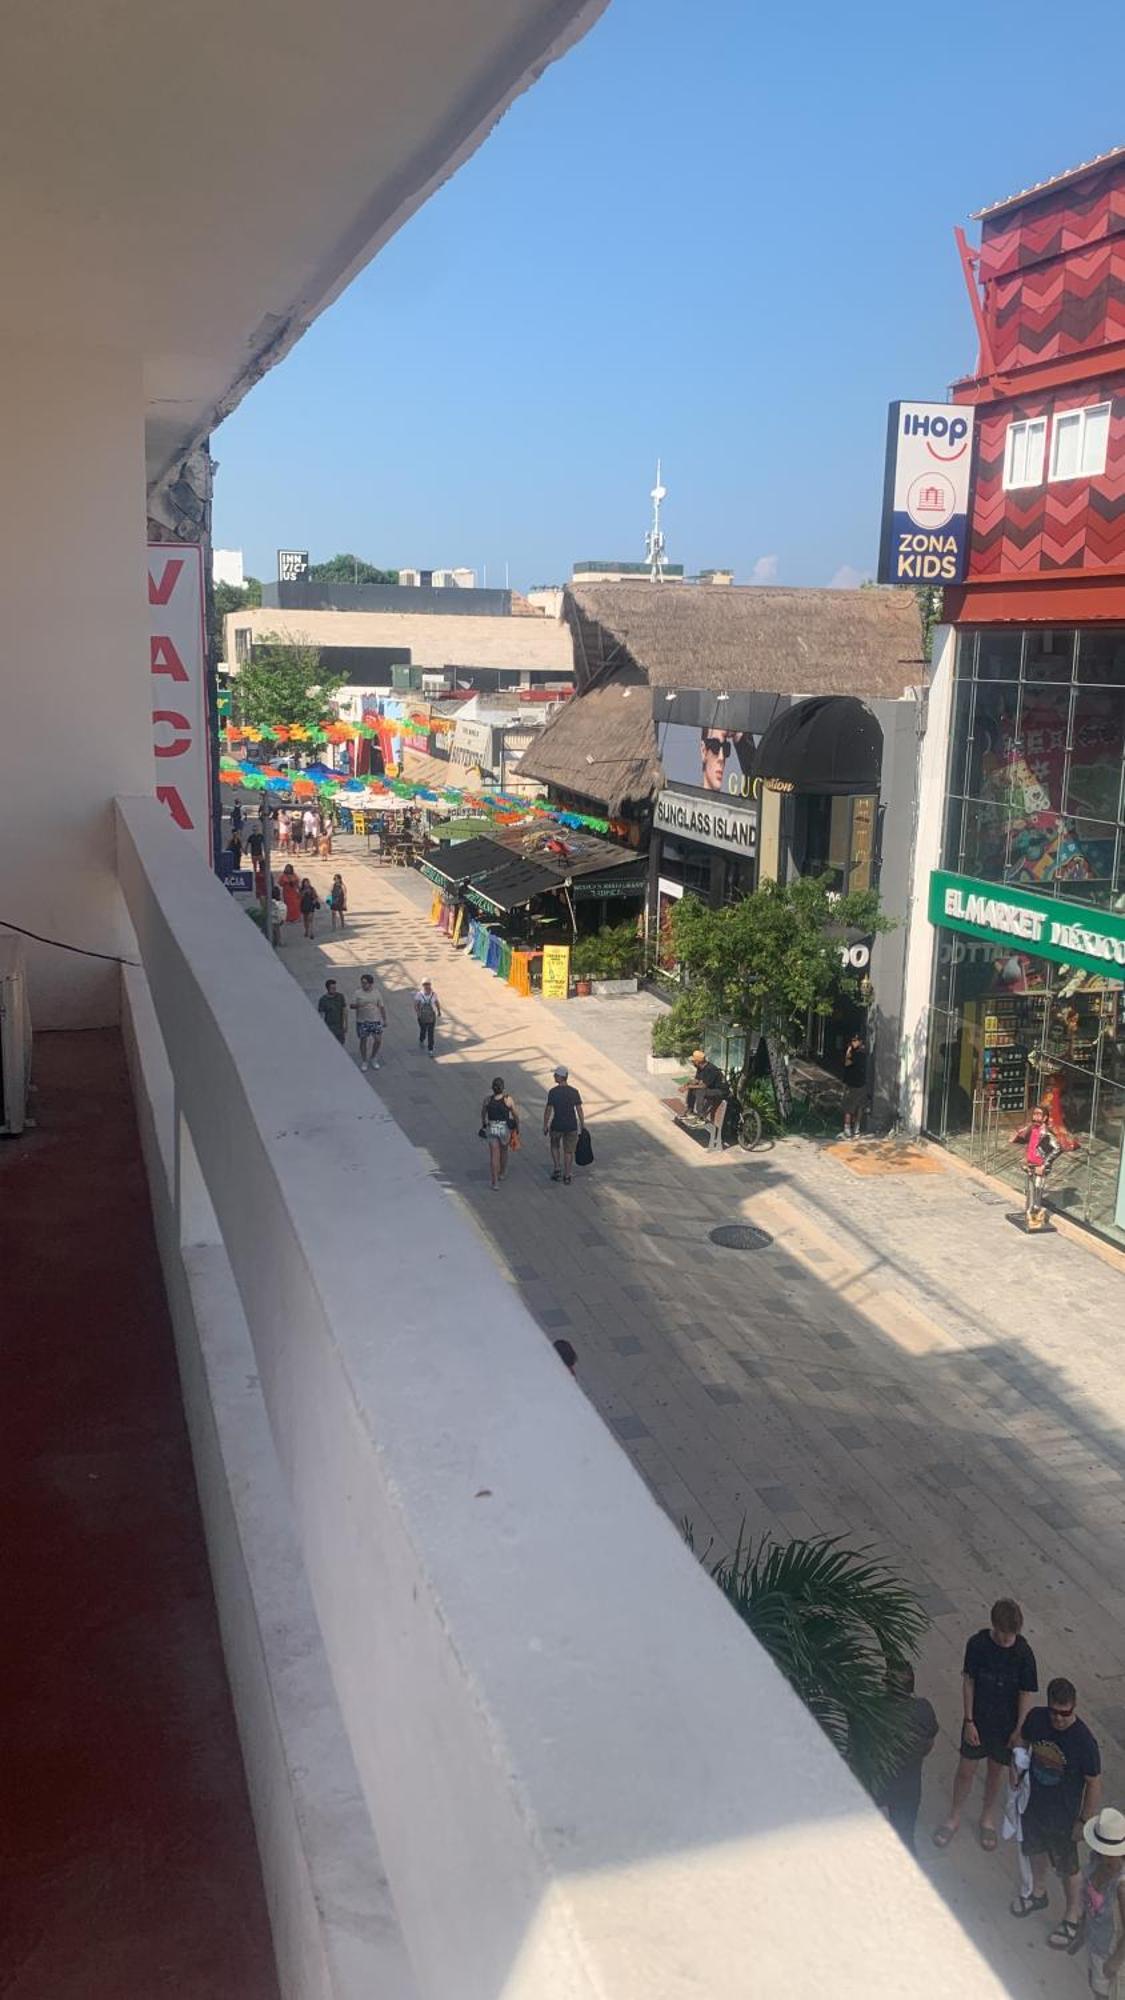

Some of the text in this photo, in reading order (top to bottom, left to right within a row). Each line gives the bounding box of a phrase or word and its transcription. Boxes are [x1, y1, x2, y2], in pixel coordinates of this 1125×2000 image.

[899, 534, 957, 553] ZONA
[897, 555, 956, 578] KIDS
[657, 802, 757, 847] SUNGLASS ISLAND
[965, 895, 1048, 941] MARKET
